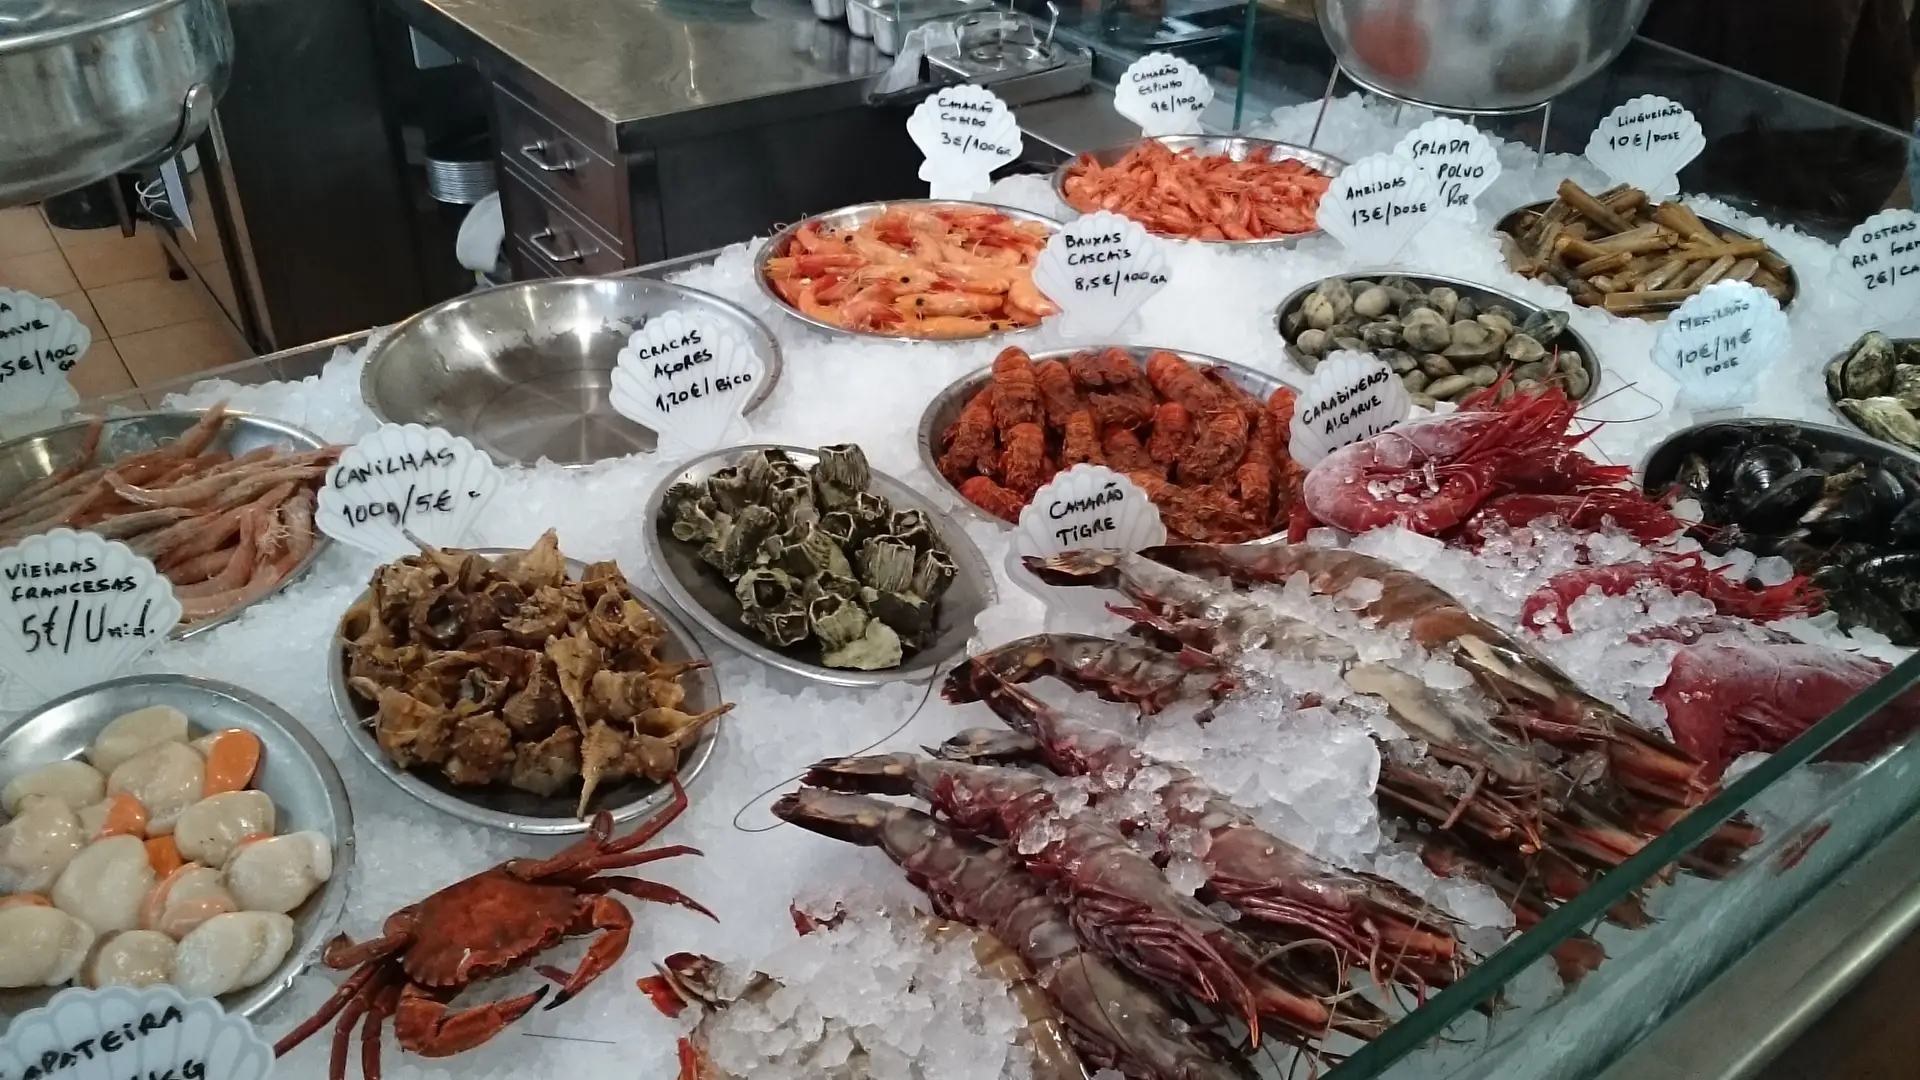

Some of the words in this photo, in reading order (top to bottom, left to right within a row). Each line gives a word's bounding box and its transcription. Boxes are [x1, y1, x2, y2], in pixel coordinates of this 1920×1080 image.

[1132, 64, 1179, 82] CAMARÃO
[938, 97, 993, 113] CAMARÃO
[1412, 139, 1470, 160] SALADA
[1437, 162, 1484, 180] POLVO
[1065, 232, 1122, 248] BRUXAS
[1862, 220, 1917, 244] OSTRAS
[1068, 248, 1132, 266] CASCAIS
[639, 330, 702, 360] CRACAS
[653, 348, 713, 380] AÇORES
[1325, 395, 1382, 435] ALGARVE
[334, 447, 455, 489] CANILHAS
[1049, 481, 1124, 520] CAMARÃO
[1055, 516, 1116, 546] TIGRE
[5, 557, 98, 581] VIEIRAS
[11, 576, 137, 602] FRANCESAS
